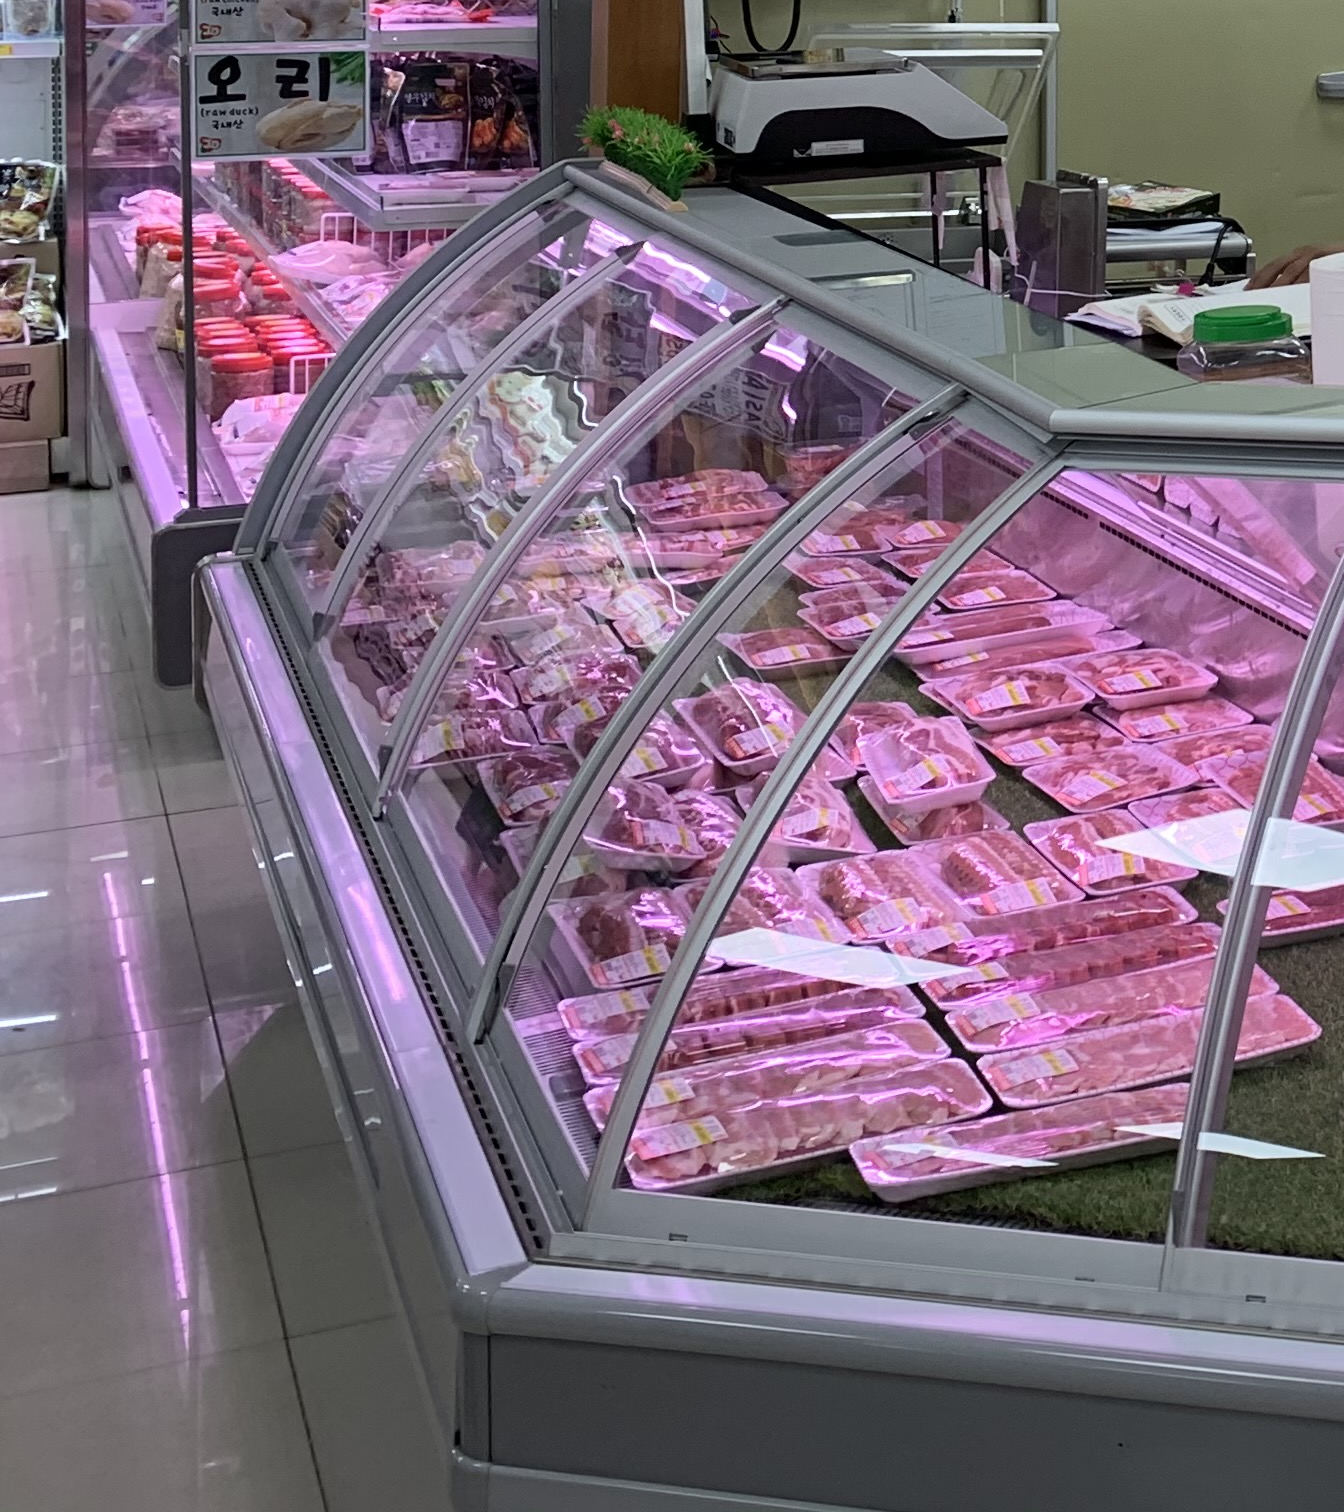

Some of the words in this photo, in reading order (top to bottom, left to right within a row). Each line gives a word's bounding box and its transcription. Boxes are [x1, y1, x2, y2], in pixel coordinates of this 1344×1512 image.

[211, 6, 245, 17] 국내산
[228, 107, 260, 117] duck)
[211, 119, 245, 130] 국내산
